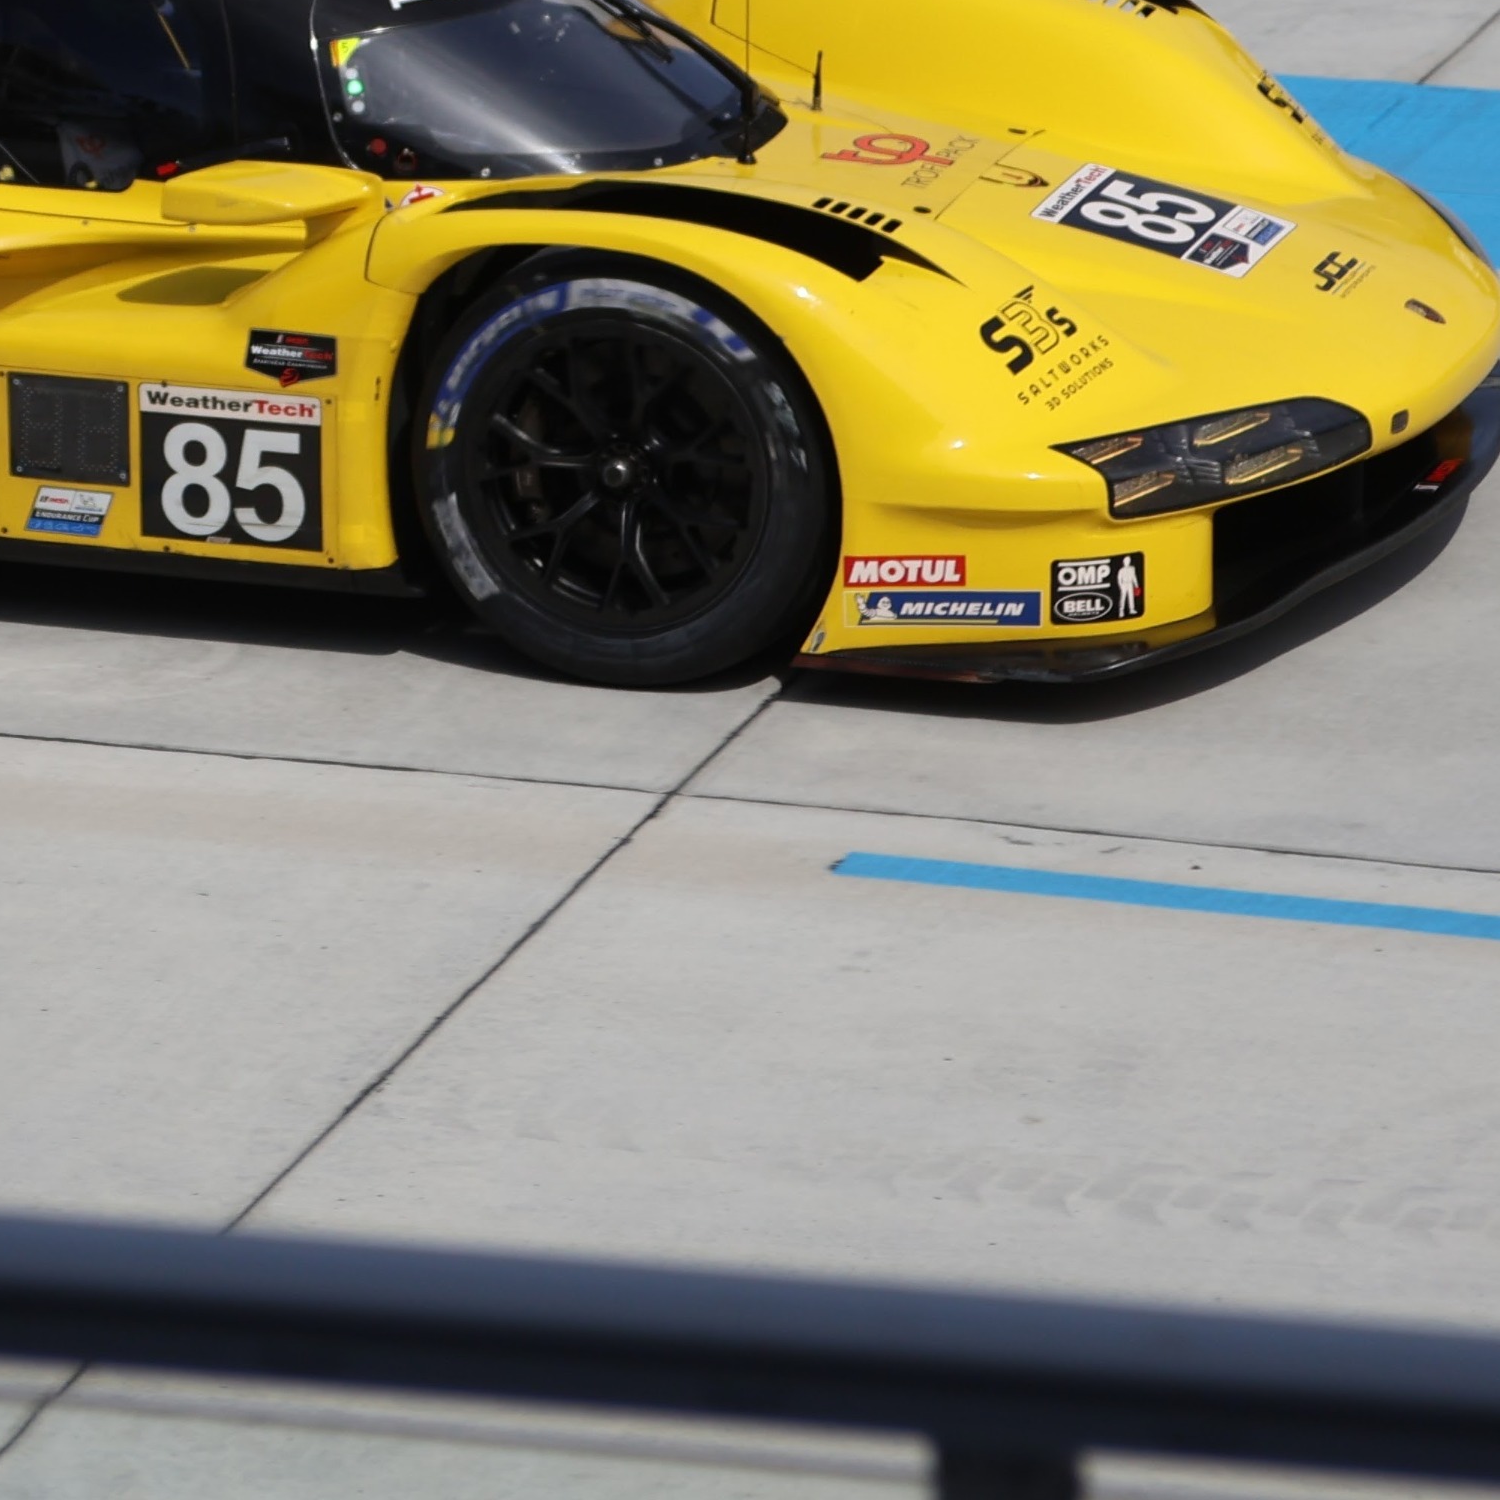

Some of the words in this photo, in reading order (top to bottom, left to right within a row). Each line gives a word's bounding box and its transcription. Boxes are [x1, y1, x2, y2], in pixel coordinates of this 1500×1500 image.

[1039, 165, 1111, 218] WeatherTech
[1080, 180, 1216, 244] 85
[1017, 335, 1110, 406] SALTWORKS
[1044, 396, 1062, 412] 3D
[1060, 357, 1114, 399] SOLUTIONS
[147, 391, 316, 418] WeatherTech
[161, 422, 306, 543] 85
[849, 560, 961, 583] MOTUL
[1058, 564, 1111, 586] OMP
[900, 602, 1025, 617] MICHELIN
[1063, 599, 1105, 613] BELL
